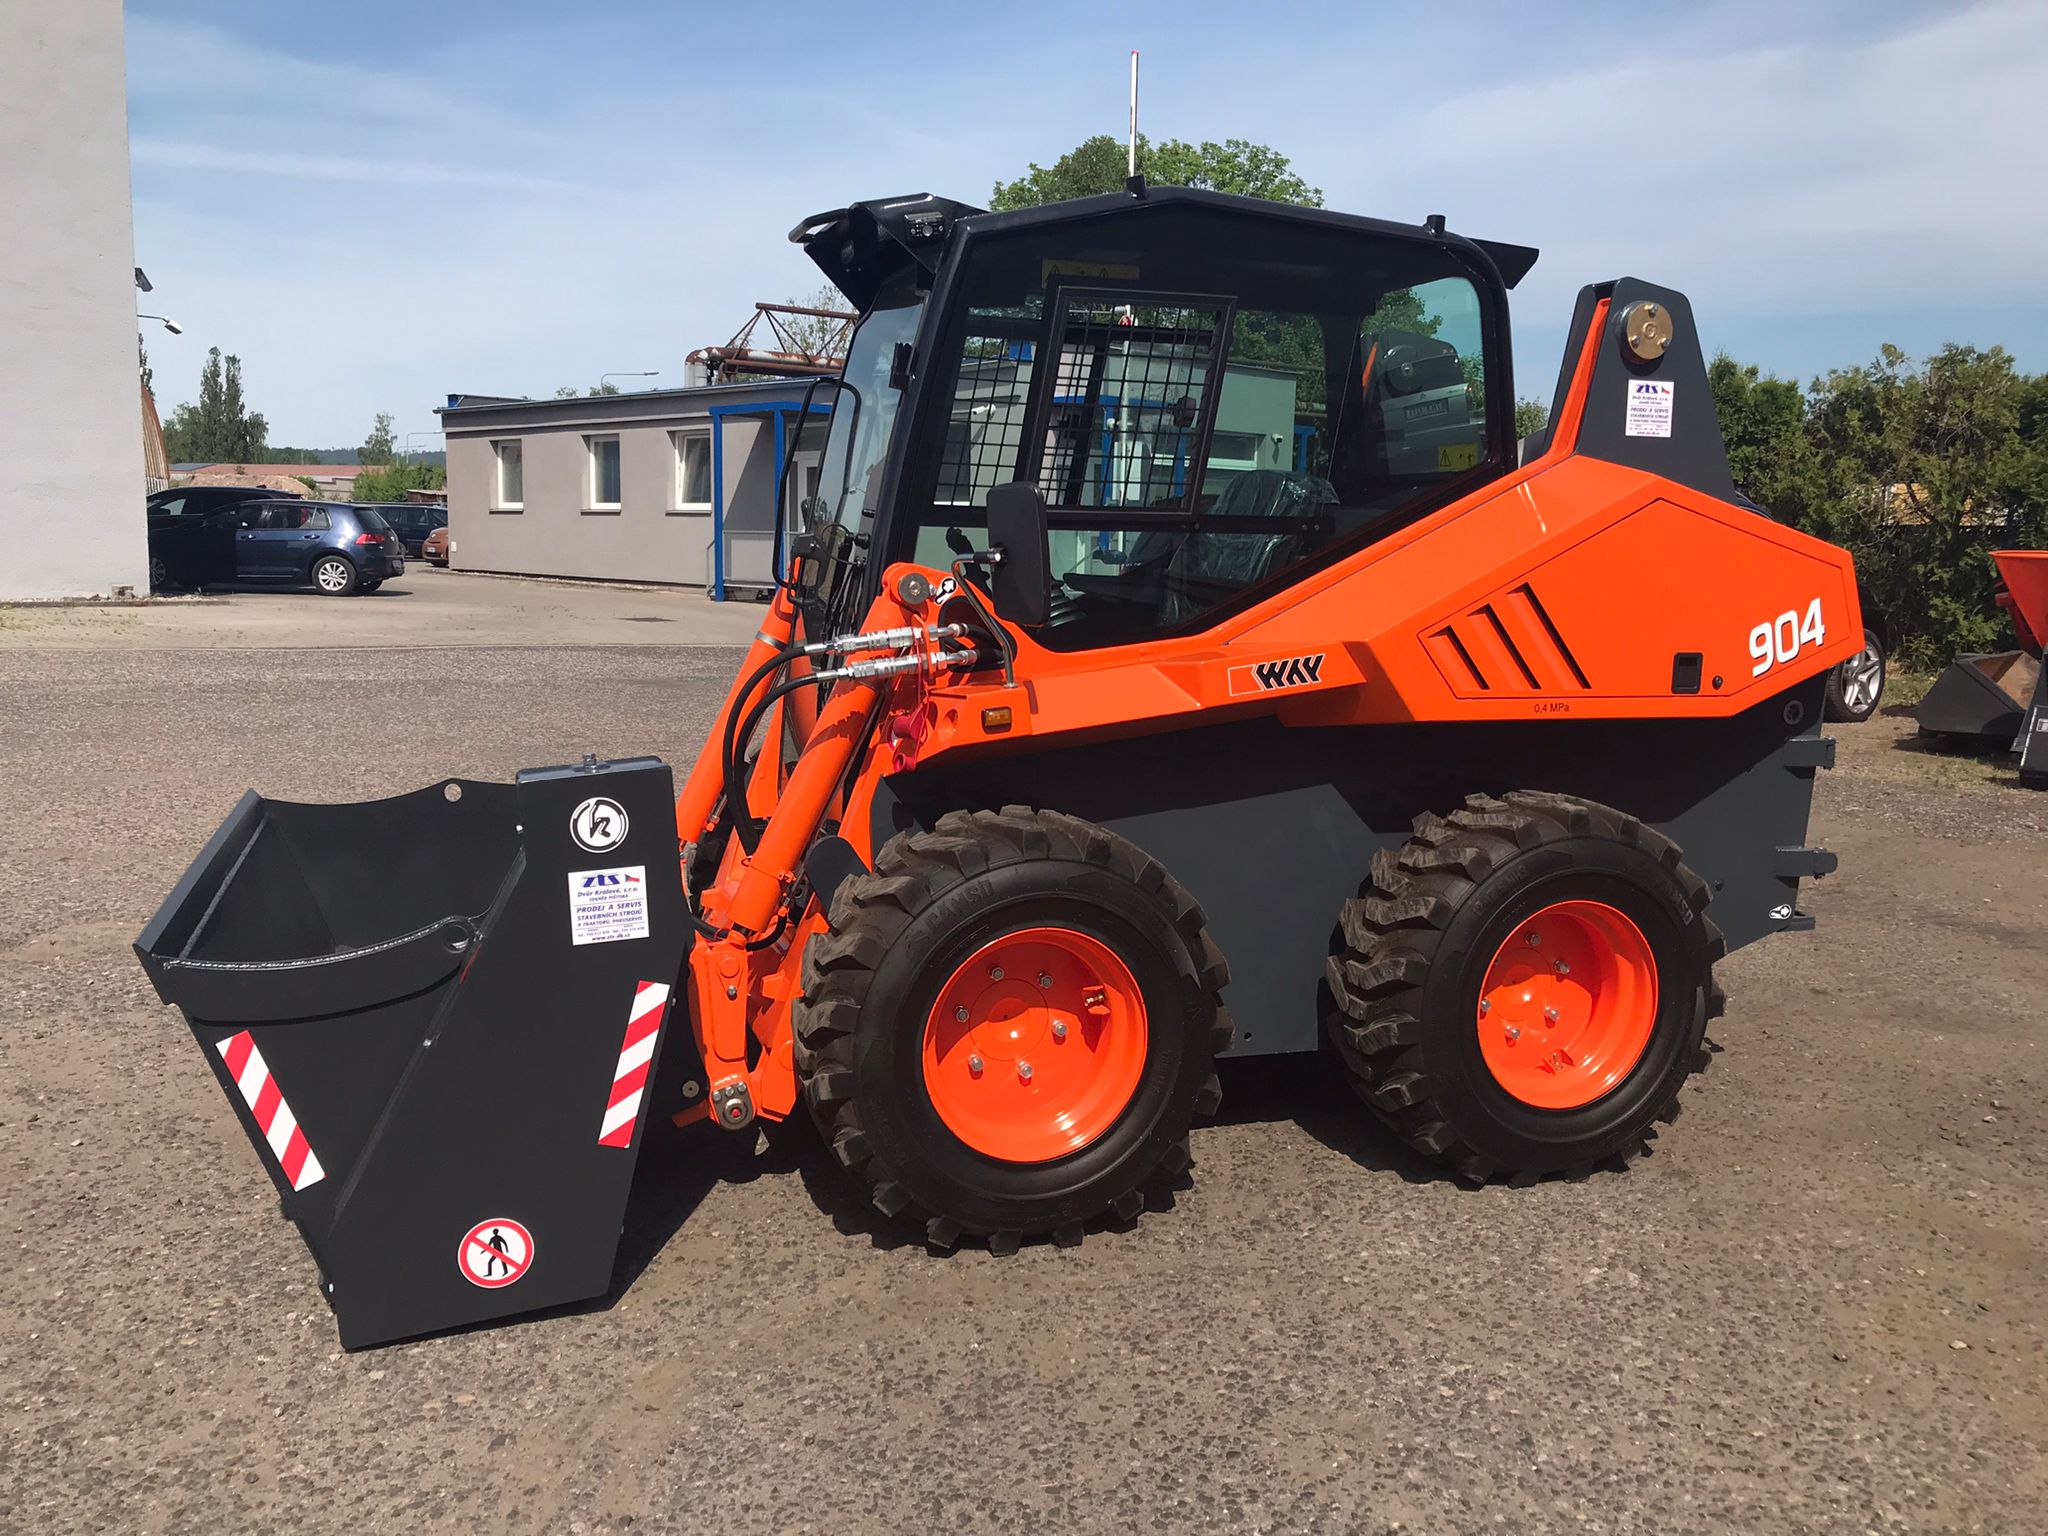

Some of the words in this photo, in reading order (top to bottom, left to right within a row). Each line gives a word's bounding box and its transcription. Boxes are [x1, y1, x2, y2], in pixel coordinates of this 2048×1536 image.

[1749, 597, 1825, 678] 904
[1255, 654, 1325, 690] WAY
[1534, 703, 1548, 714] 0,4
[1550, 702, 1570, 712] MPa
[576, 905, 605, 914] PRODEJ
[617, 901, 642, 910] SERVIS
[577, 912, 618, 922] STAVEBNÍCH
[620, 908, 642, 916] STROJŮ
